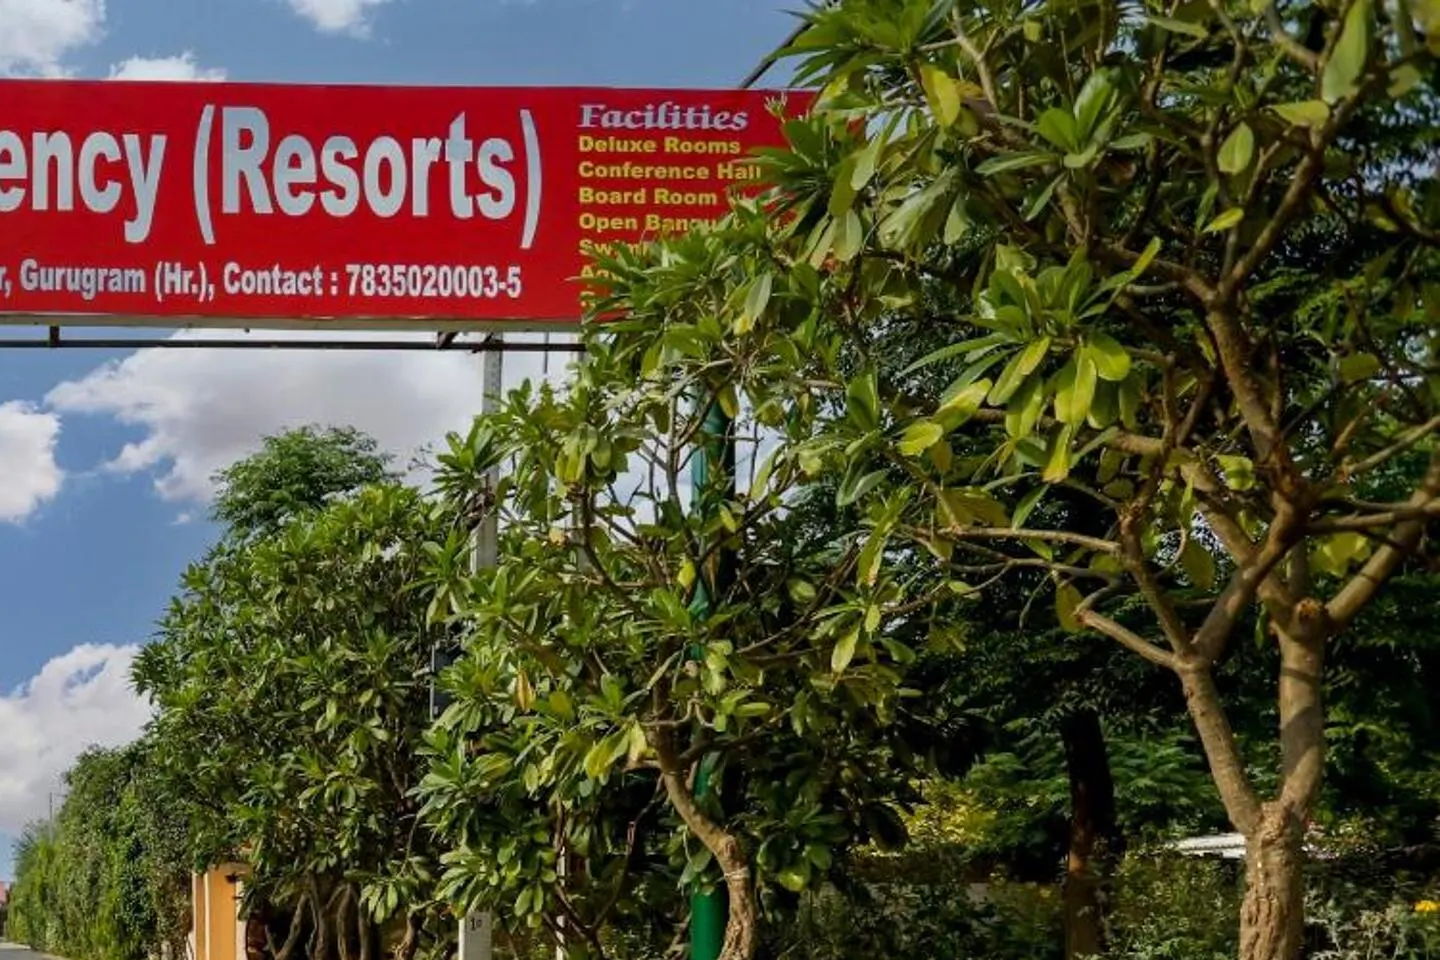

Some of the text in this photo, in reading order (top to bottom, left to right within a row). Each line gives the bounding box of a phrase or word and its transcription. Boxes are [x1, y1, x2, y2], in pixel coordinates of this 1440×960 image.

[577, 101, 749, 131] Facilities
[579, 136, 741, 154] Deluxe Rooms
[194, 103, 543, 249] (Resorts)
[579, 161, 761, 181] Conference Hall
[579, 187, 717, 205] Board Room
[579, 213, 638, 233] Open
[20, 261, 146, 299] Gurugram
[155, 262, 214, 301] (Hr.),
[224, 262, 323, 295] Contact
[346, 265, 522, 298] 7835020003-5
